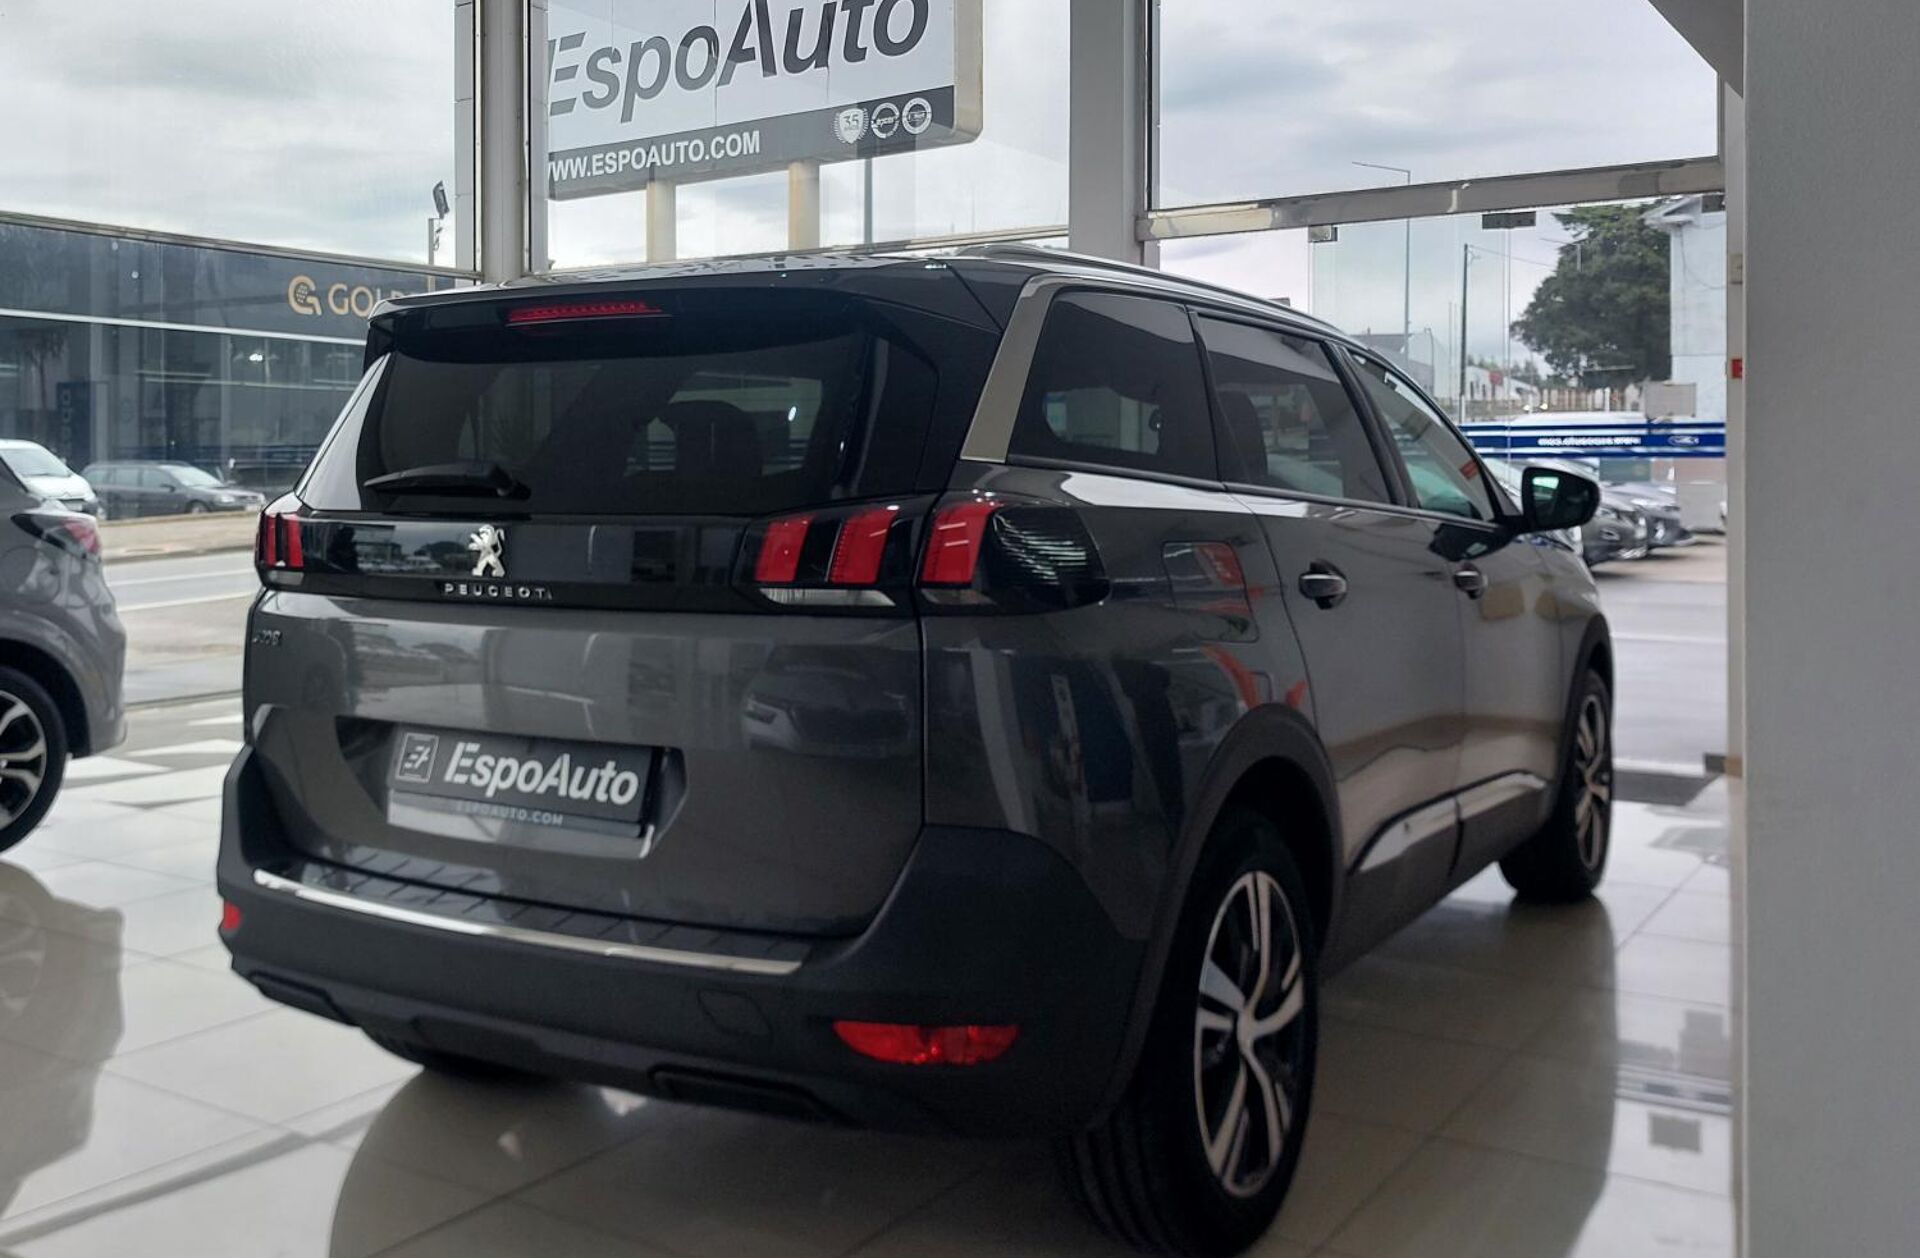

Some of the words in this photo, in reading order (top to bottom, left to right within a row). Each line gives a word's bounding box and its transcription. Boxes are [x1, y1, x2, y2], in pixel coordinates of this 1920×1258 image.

[548, 0, 930, 123] EspoAuto
[547, 130, 760, 182] WW.ESPOAUTO.COM
[444, 583, 546, 599] PEUGEOT
[443, 741, 640, 805] EspoAuto
[456, 801, 564, 826] ESPOAUTO.COM
